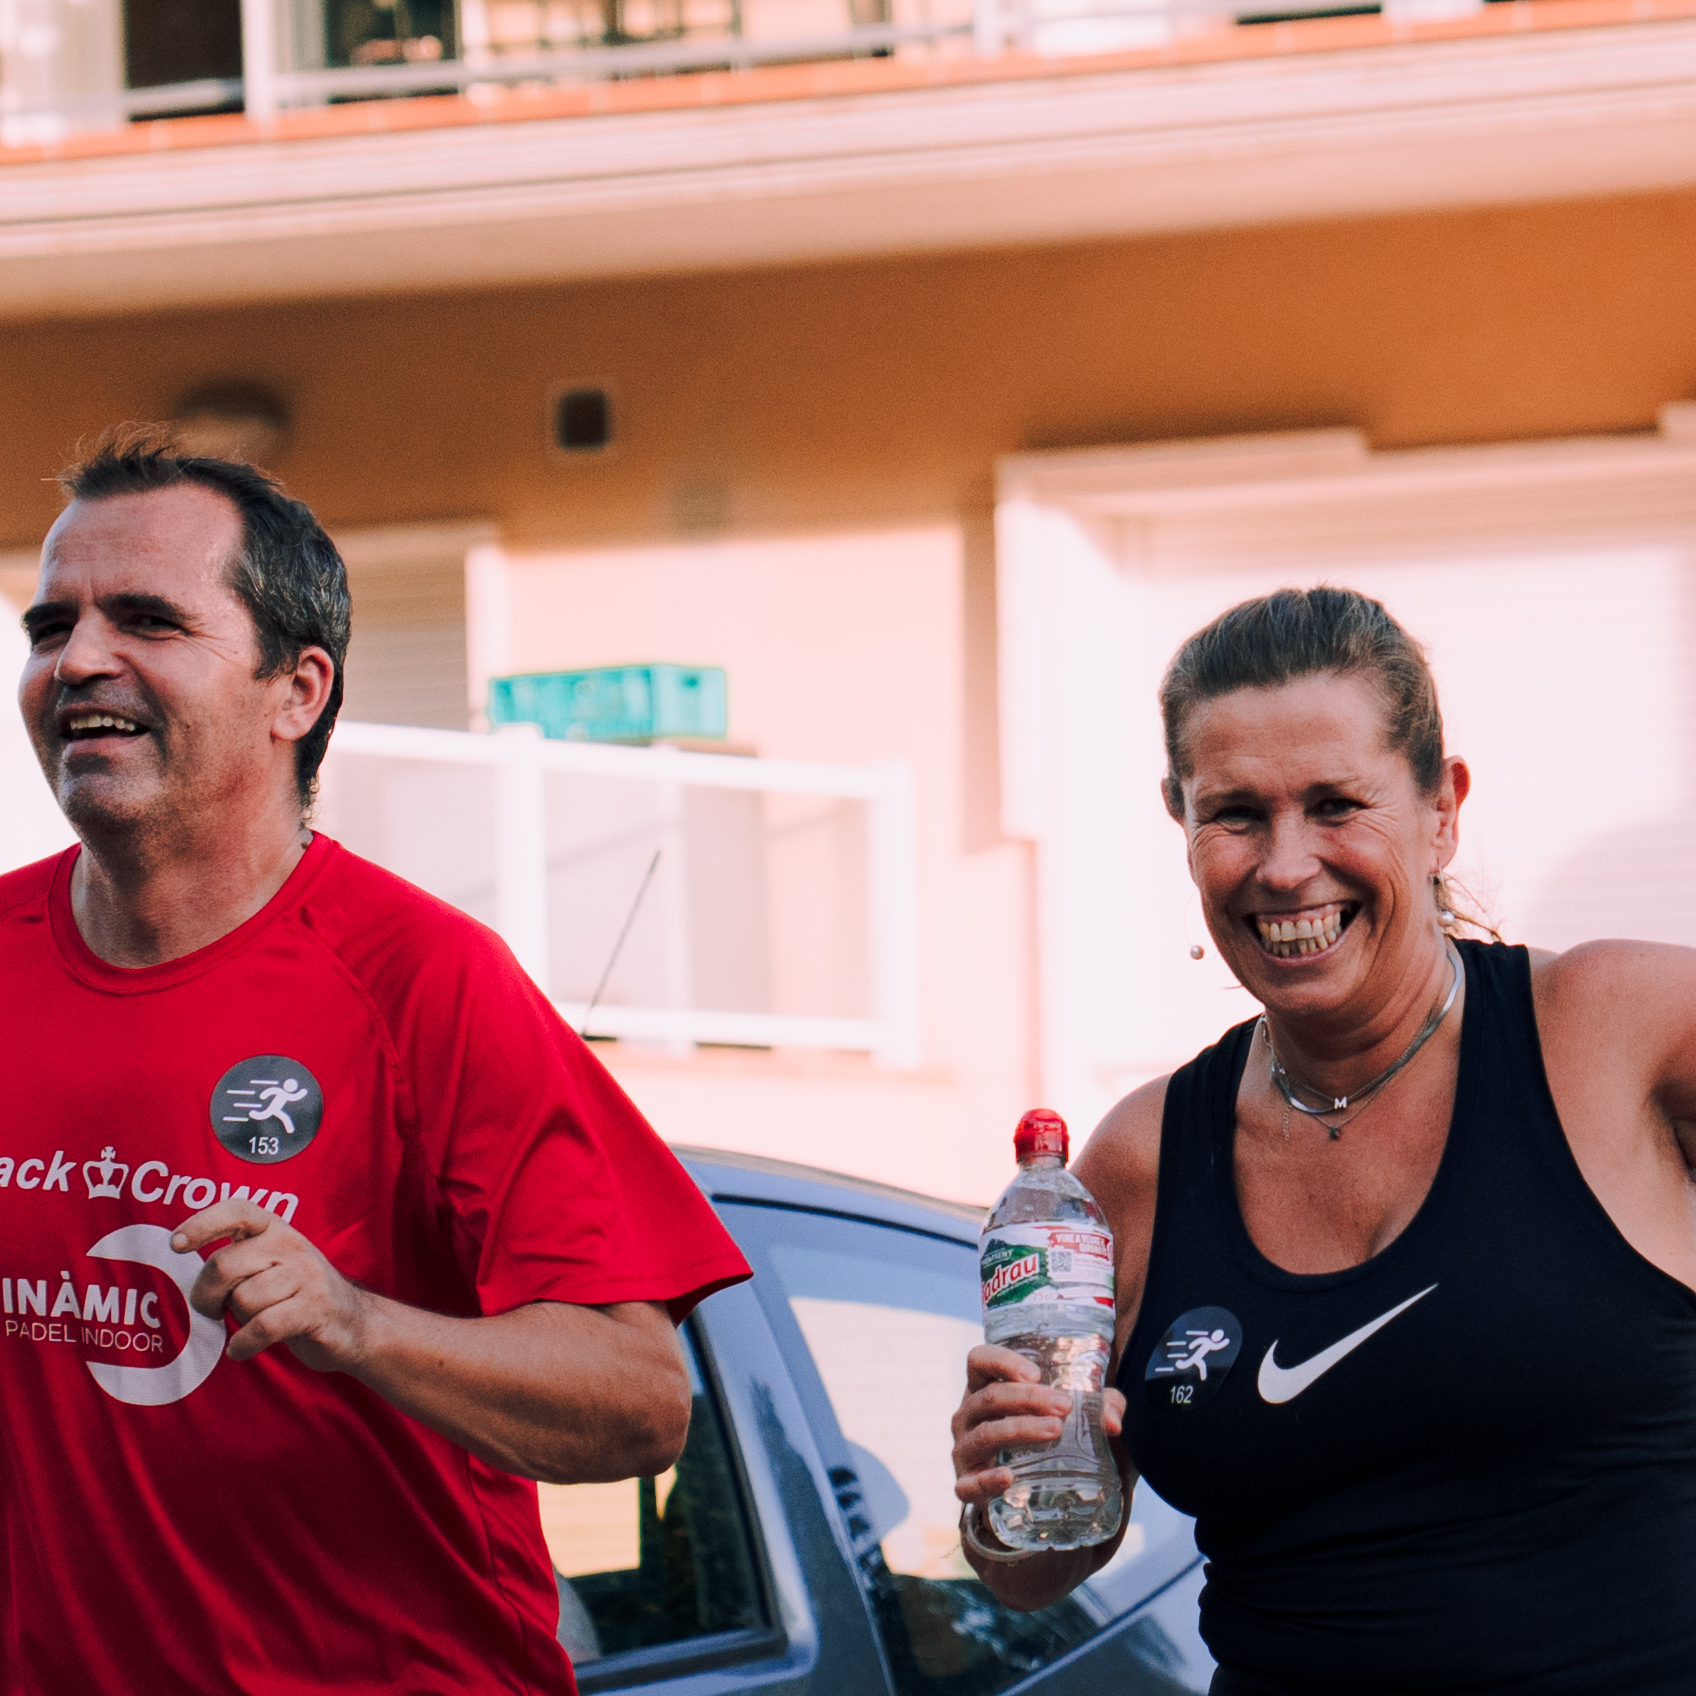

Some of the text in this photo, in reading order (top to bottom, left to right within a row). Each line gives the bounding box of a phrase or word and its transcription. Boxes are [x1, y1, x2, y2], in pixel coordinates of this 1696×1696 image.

[1334, 1096, 1348, 1110] M
[248, 1136, 280, 1155] 153
[131, 1160, 300, 1225] Crown
[982, 1255, 1038, 1302] adrau
[5, 1320, 164, 1353] PADEL INDOOR
[1170, 1385, 1194, 1404] 162
